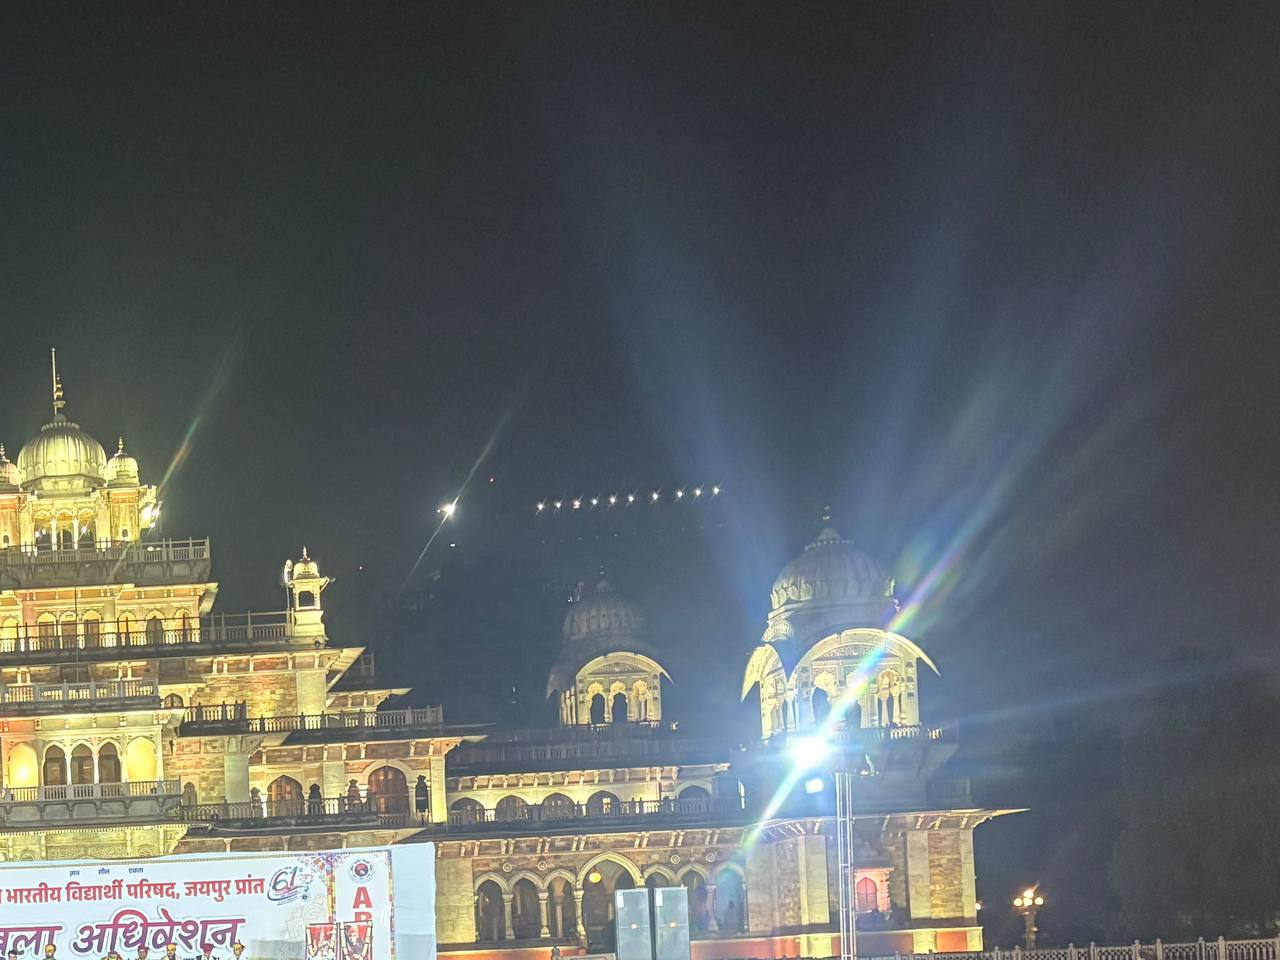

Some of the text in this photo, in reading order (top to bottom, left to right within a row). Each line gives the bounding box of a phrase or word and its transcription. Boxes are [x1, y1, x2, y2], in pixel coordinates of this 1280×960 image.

[6, 882, 62, 904] भारतीय
[65, 879, 124, 902] विद्यार्थी
[126, 878, 180, 899] परिषद,
[184, 880, 231, 902] जयपुर
[235, 874, 265, 896] प्रांत
[73, 908, 246, 953] अधिवेशन
